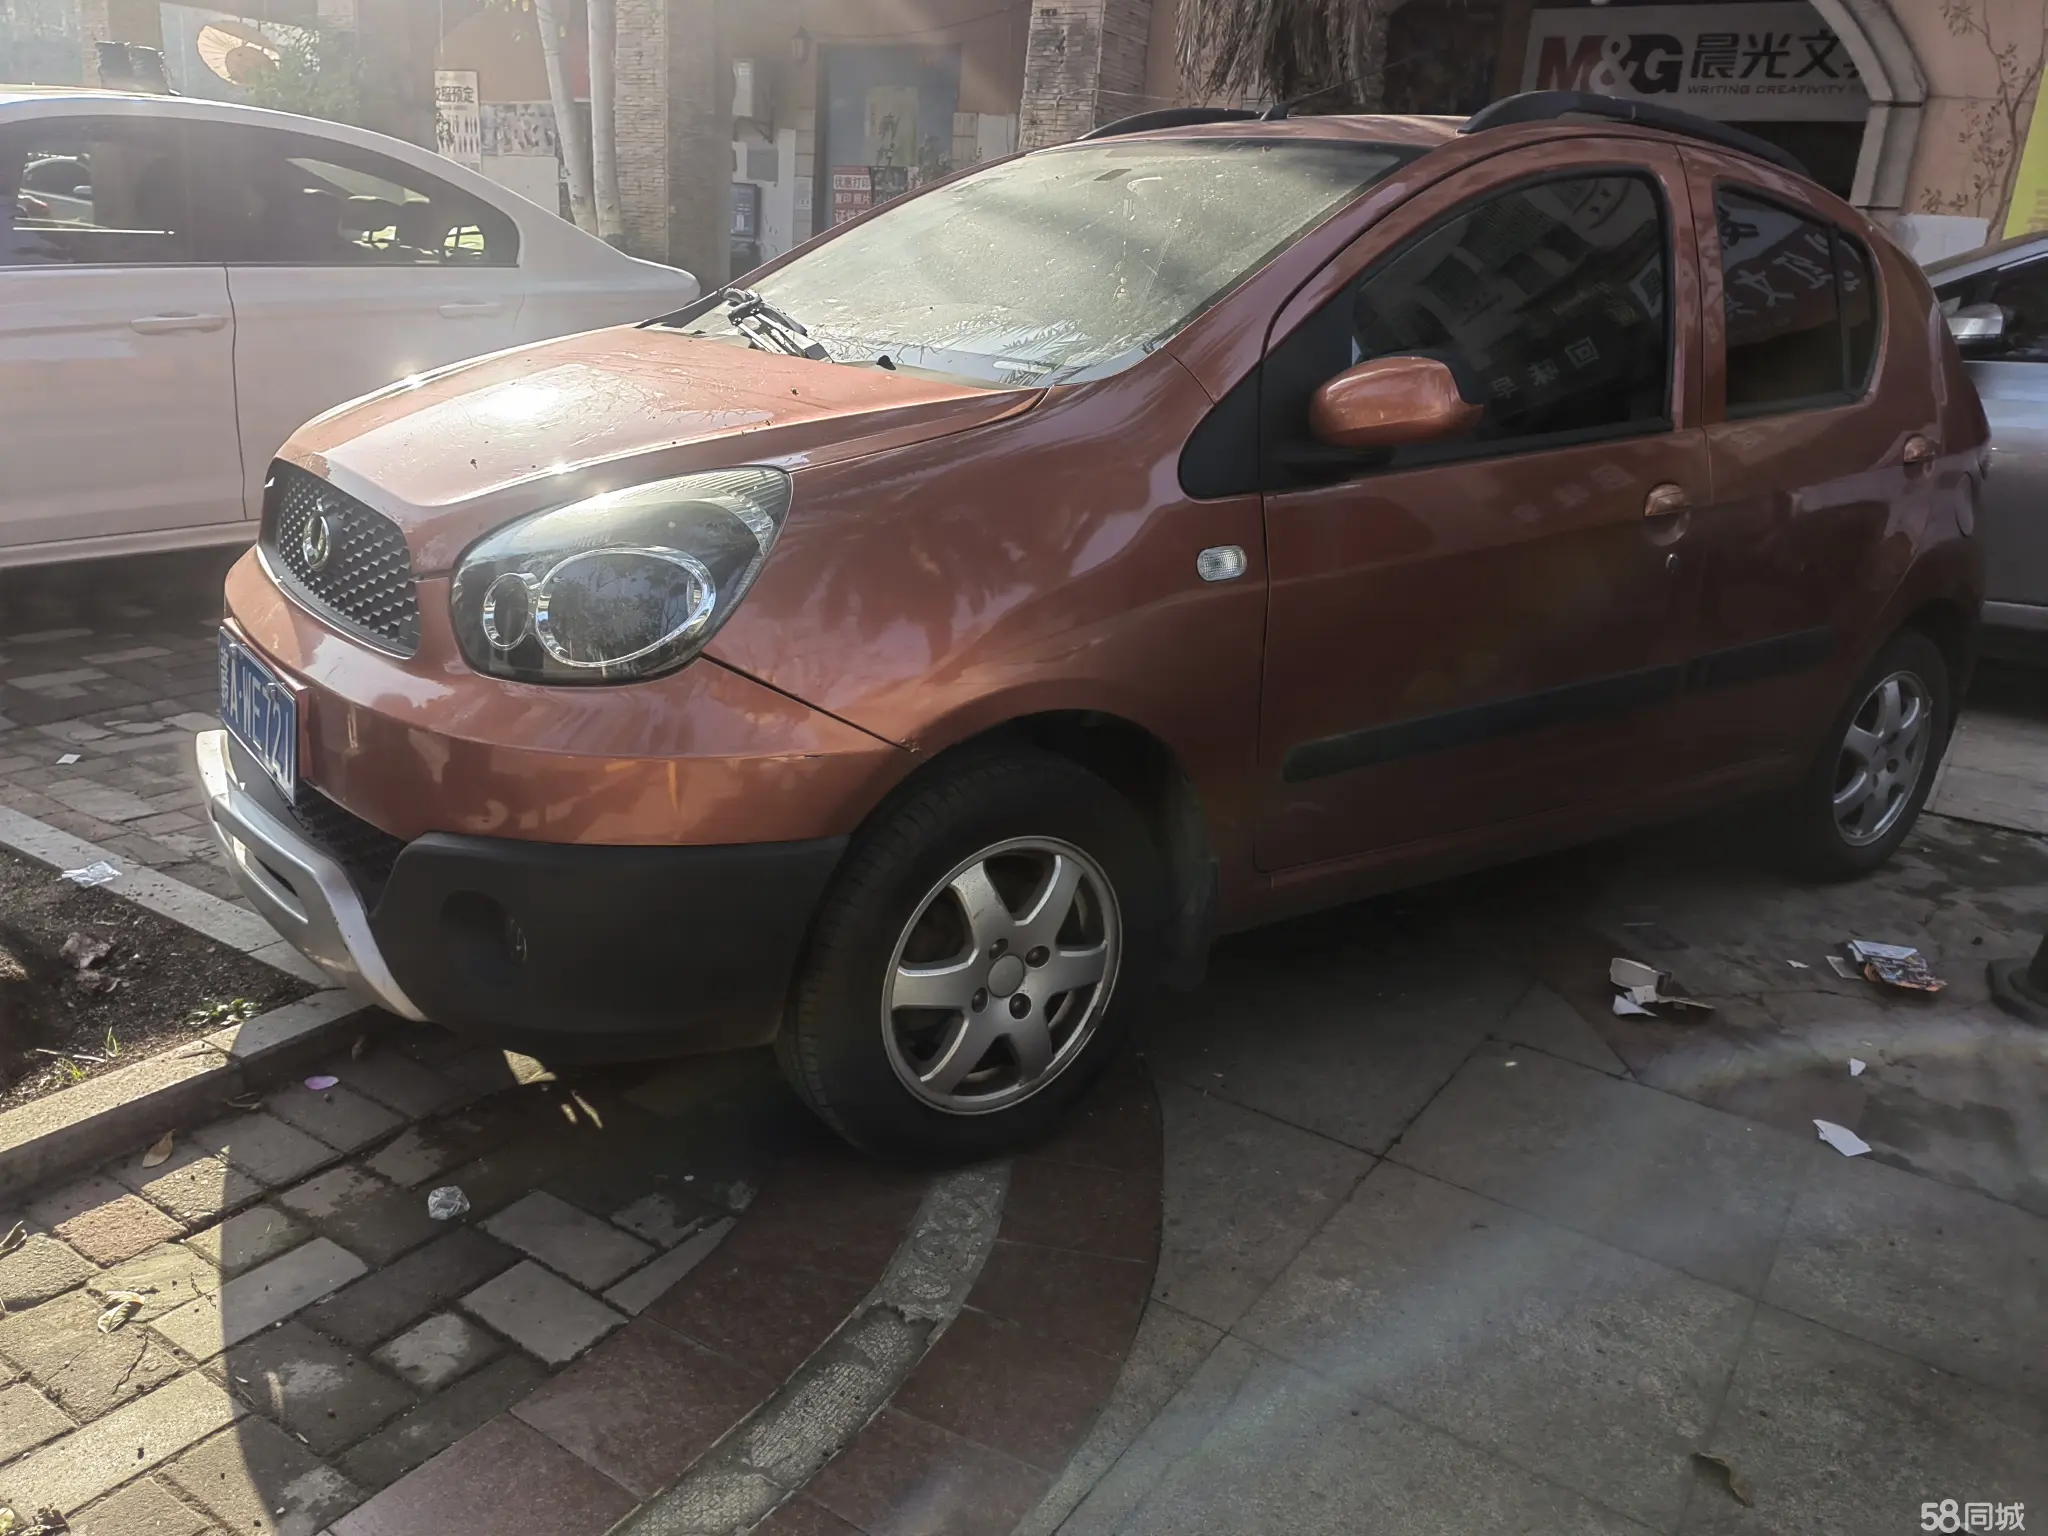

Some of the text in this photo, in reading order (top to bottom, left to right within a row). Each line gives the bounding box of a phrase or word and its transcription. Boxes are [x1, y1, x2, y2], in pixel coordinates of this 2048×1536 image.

[1535, 34, 1684, 95] M&G
[1690, 30, 1860, 79] 晨光文
[1687, 85, 1750, 95] WRITING
[1756, 85, 1845, 95] CREATIVITY
